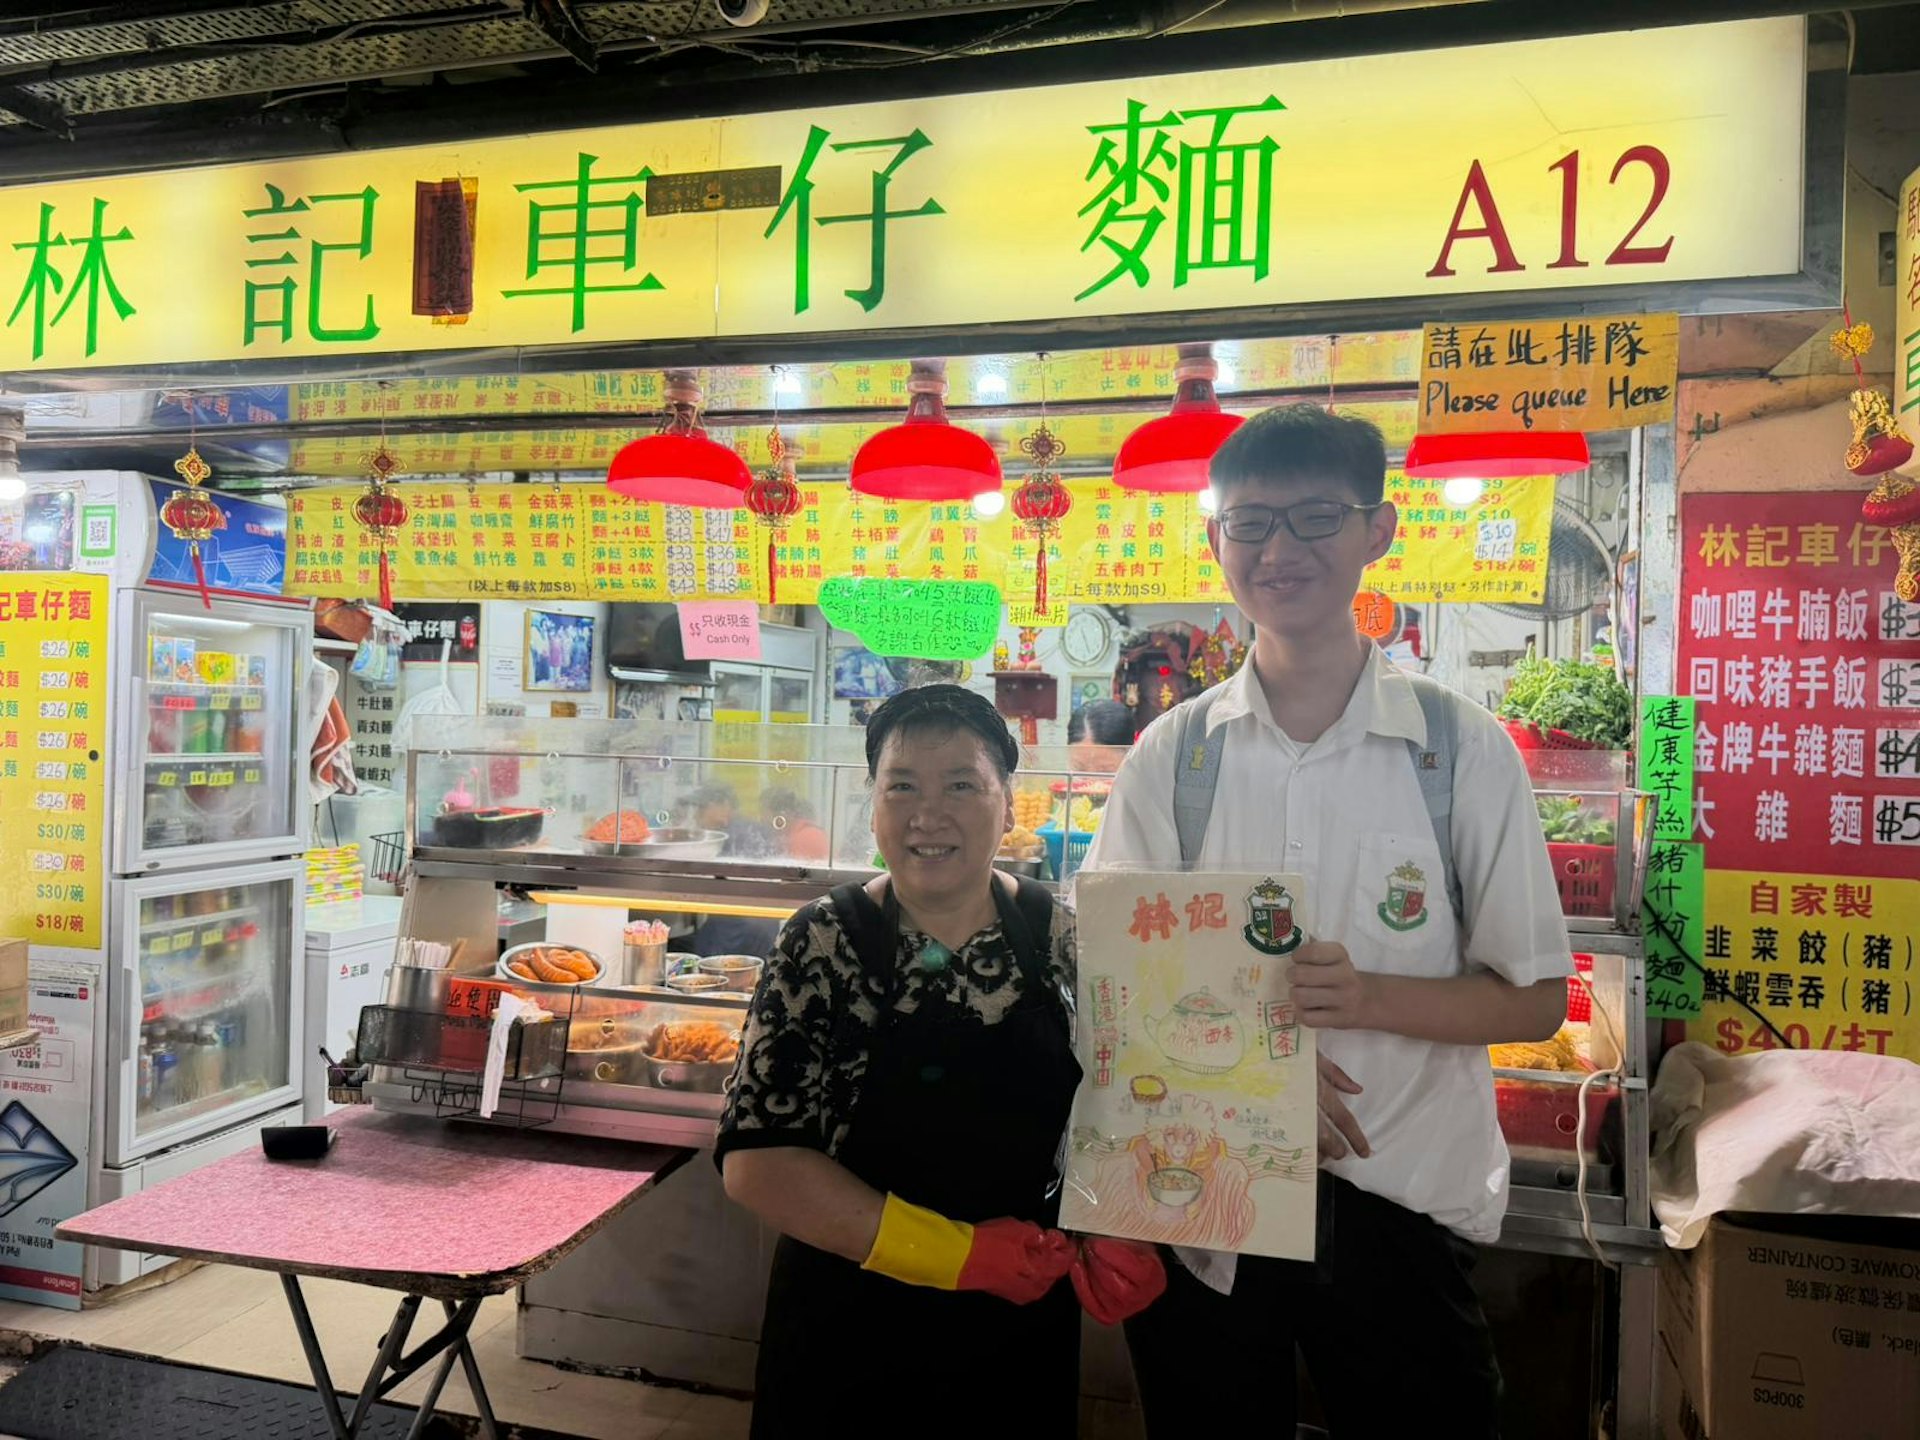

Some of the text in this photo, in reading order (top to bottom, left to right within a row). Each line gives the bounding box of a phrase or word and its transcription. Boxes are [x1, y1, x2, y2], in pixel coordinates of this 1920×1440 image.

[6, 94, 1288, 361] 林記車仔麵
[1426, 145, 1675, 277] A12
[1428, 321, 1650, 368] 請在此排隊
[1426, 375, 1670, 428] Please queue Here
[1699, 521, 1893, 568] 林記車仔
[1095, 562, 1164, 577] 五香肉丁
[402, 619, 457, 639] 車仔麵
[702, 614, 750, 628] 只收現金
[707, 634, 750, 646] Cash Only
[1689, 655, 1867, 709] 回味豬手飯
[1693, 721, 1865, 779] 金牌牛雜麵
[1750, 880, 1873, 919] 自家製
[1716, 1017, 1894, 1056] $40/打
[1748, 1247, 1845, 1271] CONTAINER
[1752, 1387, 1805, 1409] 300PCS
